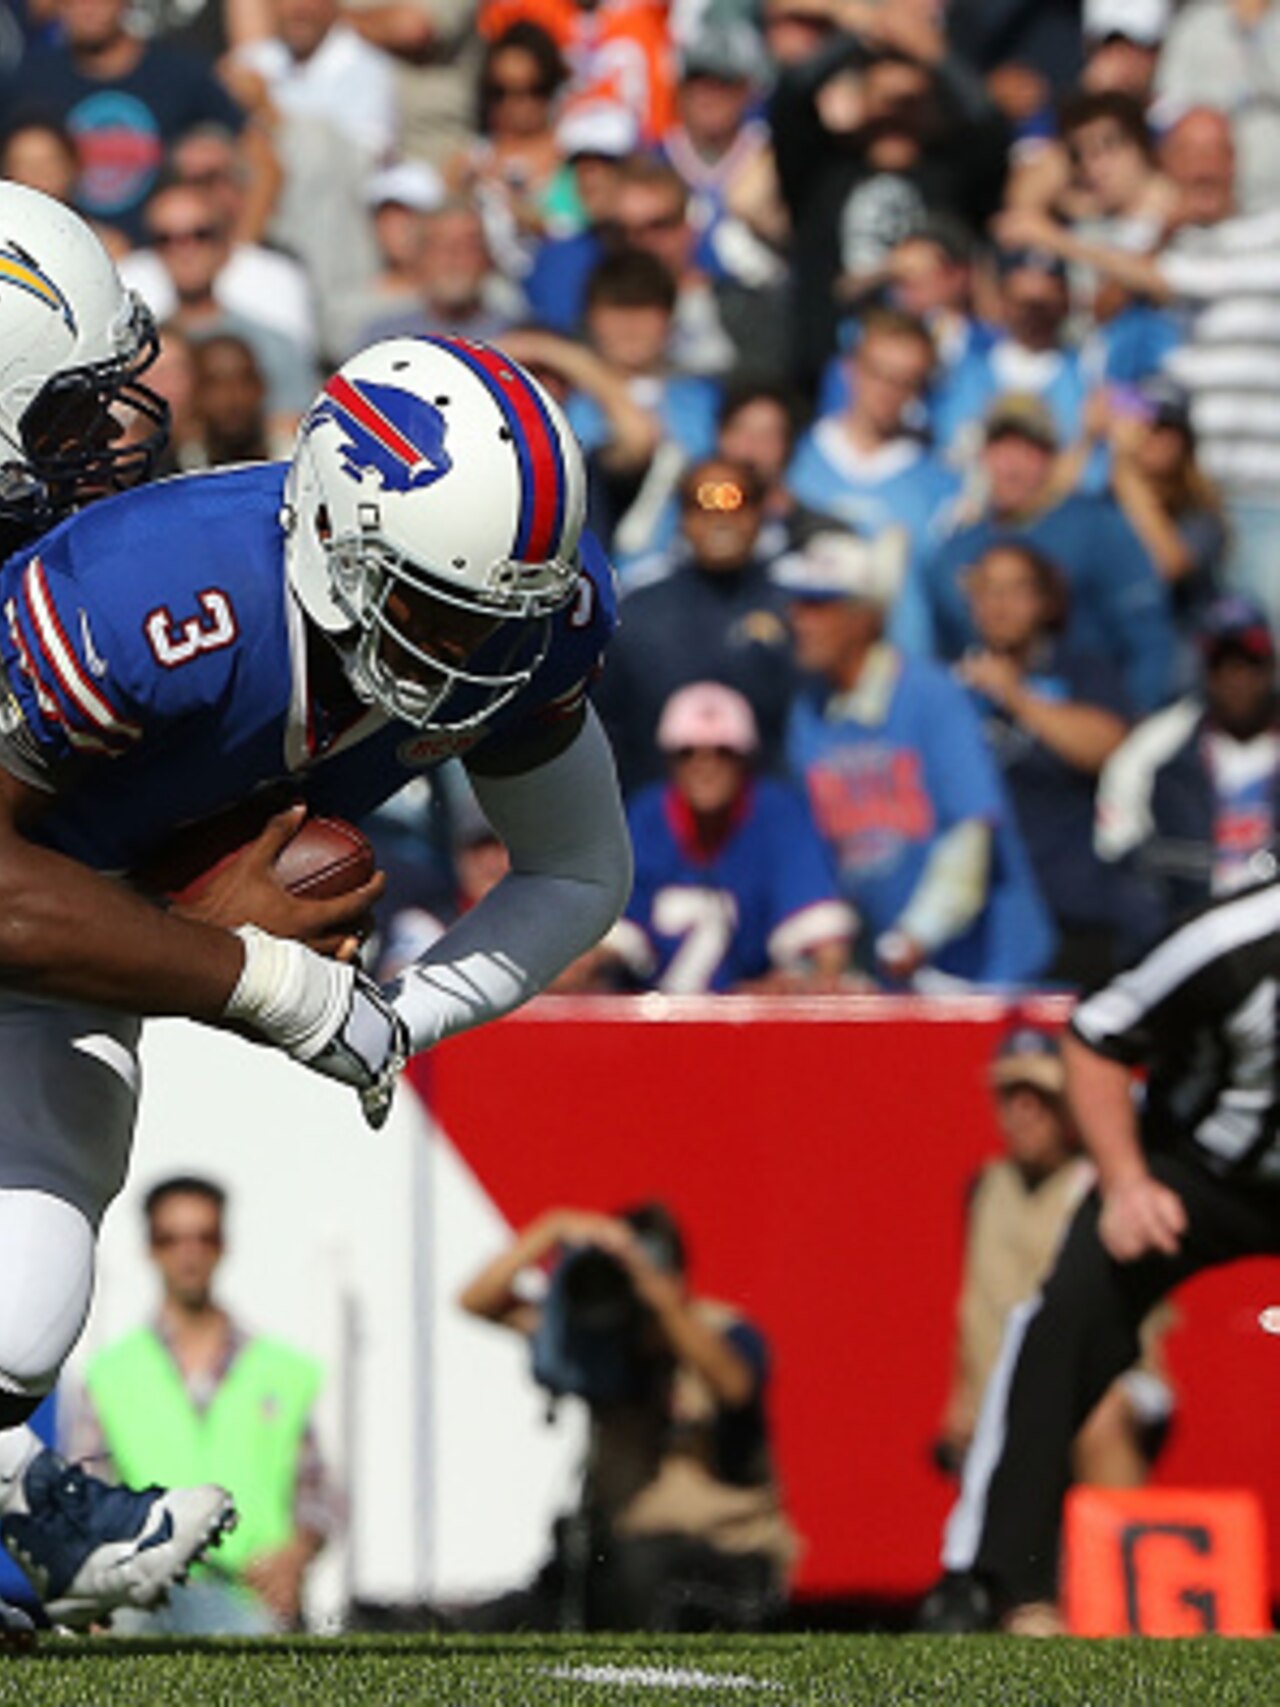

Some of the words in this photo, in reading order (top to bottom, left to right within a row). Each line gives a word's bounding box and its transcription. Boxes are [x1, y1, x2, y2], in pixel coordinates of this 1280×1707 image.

[143, 586, 238, 668] 3
[651, 885, 738, 994] 7
[1119, 1521, 1217, 1638] G
